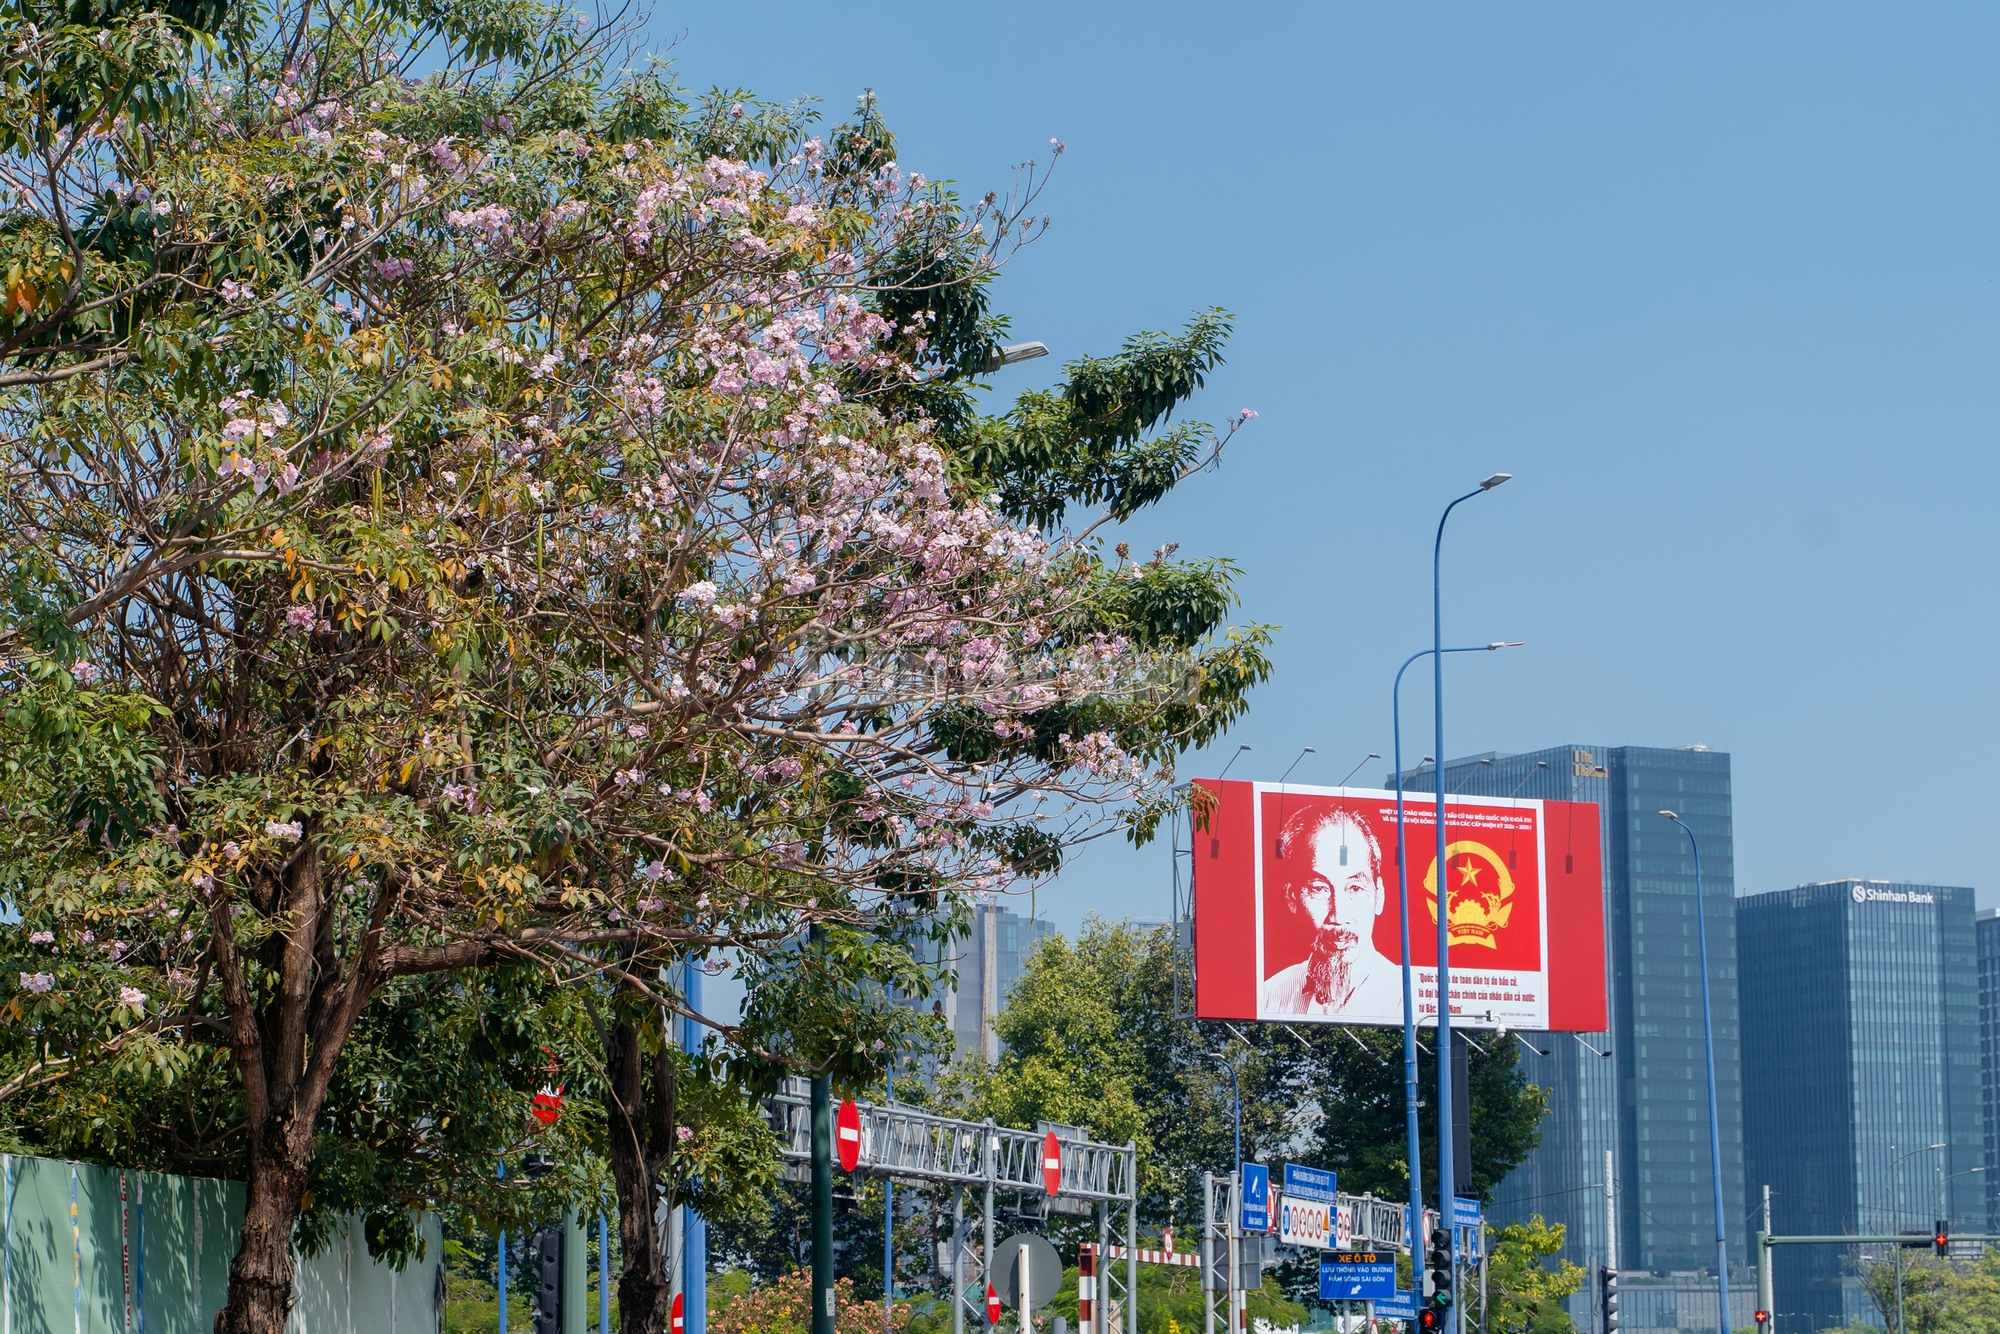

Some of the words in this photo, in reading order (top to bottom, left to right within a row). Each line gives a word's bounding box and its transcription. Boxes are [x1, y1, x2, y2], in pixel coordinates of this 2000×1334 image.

[1581, 750, 1592, 763] The
[1866, 888, 1907, 902] Shinhan
[1908, 891, 1934, 904] Bank
[1452, 975, 1458, 983] do
[1460, 975, 1471, 984] toàn
[1473, 976, 1483, 984] dân
[1491, 976, 1497, 985] do
[1419, 988, 1423, 997] là
[1462, 990, 1476, 999] chính
[1489, 991, 1502, 1000] nhân
[1503, 992, 1513, 1001] dân
[1426, 1003, 1436, 1013] Bắc
[1339, 1254, 1352, 1262] XE
[1354, 1253, 1361, 1263] Ô
[1363, 1253, 1376, 1263] TÔ
